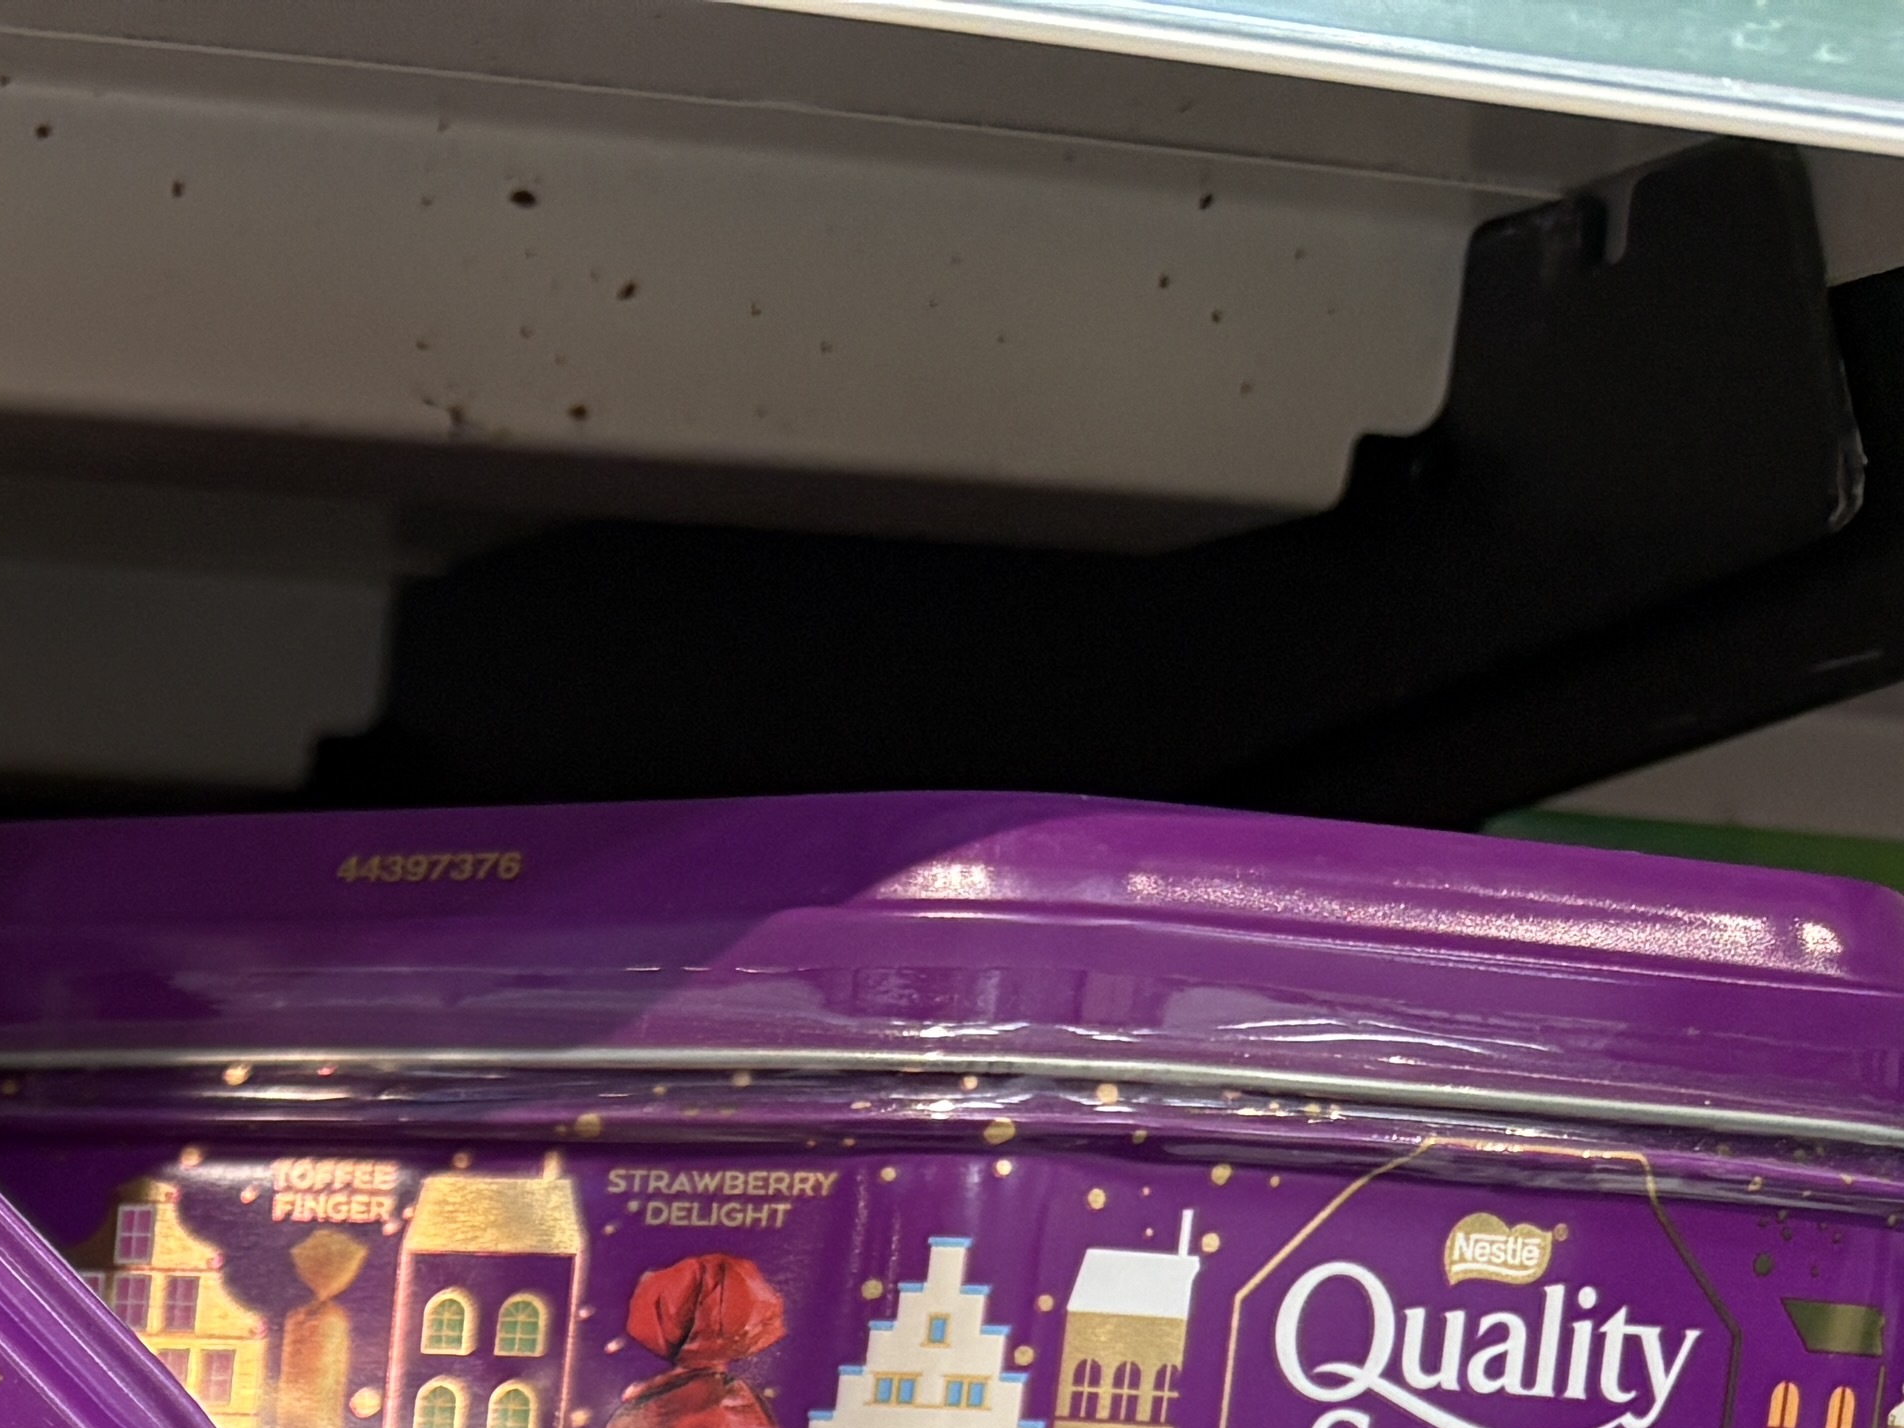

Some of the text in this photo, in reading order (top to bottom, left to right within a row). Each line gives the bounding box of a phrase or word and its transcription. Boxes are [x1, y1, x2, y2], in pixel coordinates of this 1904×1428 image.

[337, 852, 522, 883] 44397376
[271, 1157, 398, 1192] TOFFEE
[607, 1168, 838, 1199] STRAWBERRY
[272, 1192, 394, 1223] FINGER
[644, 1201, 791, 1230] DELIGHT
